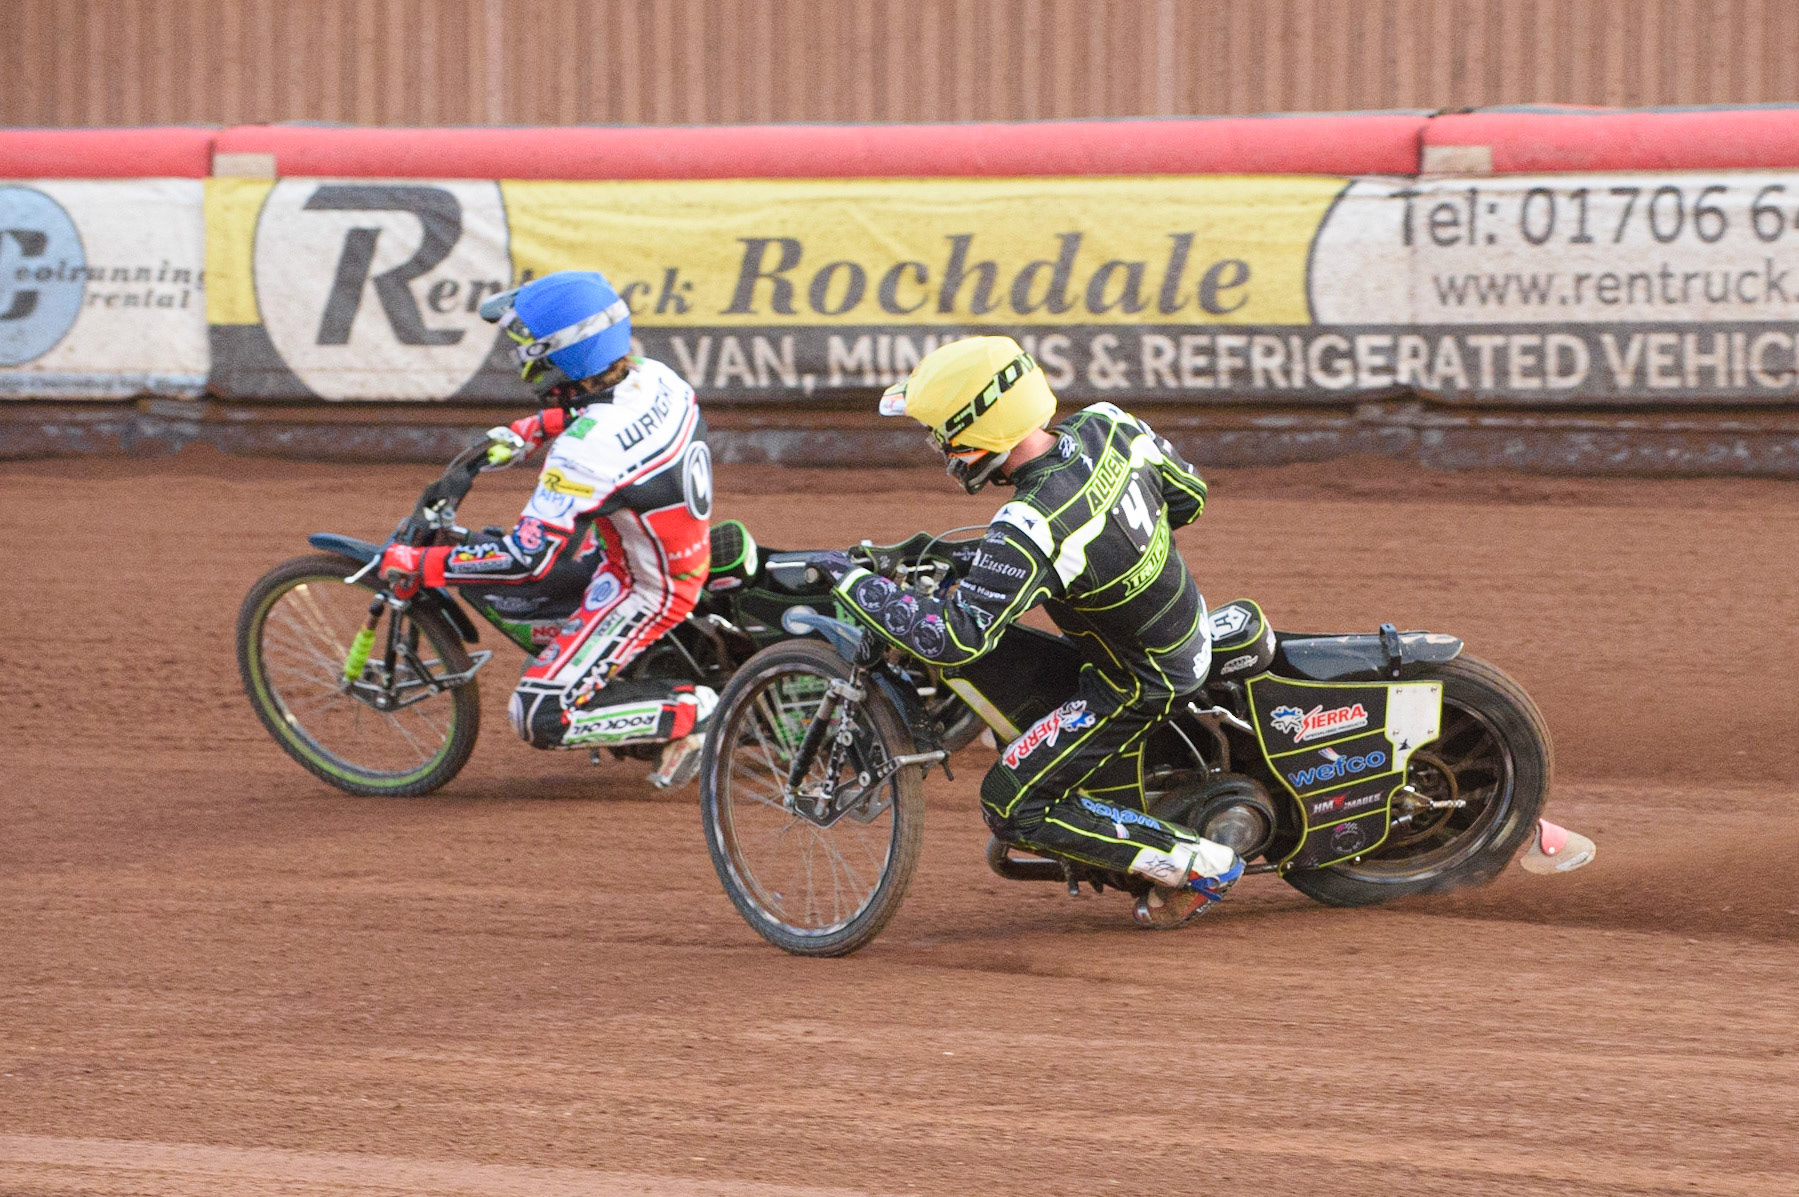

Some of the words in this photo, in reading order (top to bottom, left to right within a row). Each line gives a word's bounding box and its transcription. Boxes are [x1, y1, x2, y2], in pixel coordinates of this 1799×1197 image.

[1390, 186, 1498, 247] Tel:
[1520, 184, 1729, 245] 01706
[1751, 184, 1799, 243] 6
[718, 231, 1251, 315] Rochdale
[671, 335, 813, 393] VAN,
[1086, 333, 1132, 390] &
[1141, 332, 1591, 391] REFRIGERATED
[1603, 331, 1799, 390] VEHIC
[1120, 479, 1154, 538] 4
[978, 552, 1027, 580] Euston
[1294, 704, 1366, 742] SIERRA
[1287, 750, 1386, 788] wefco
